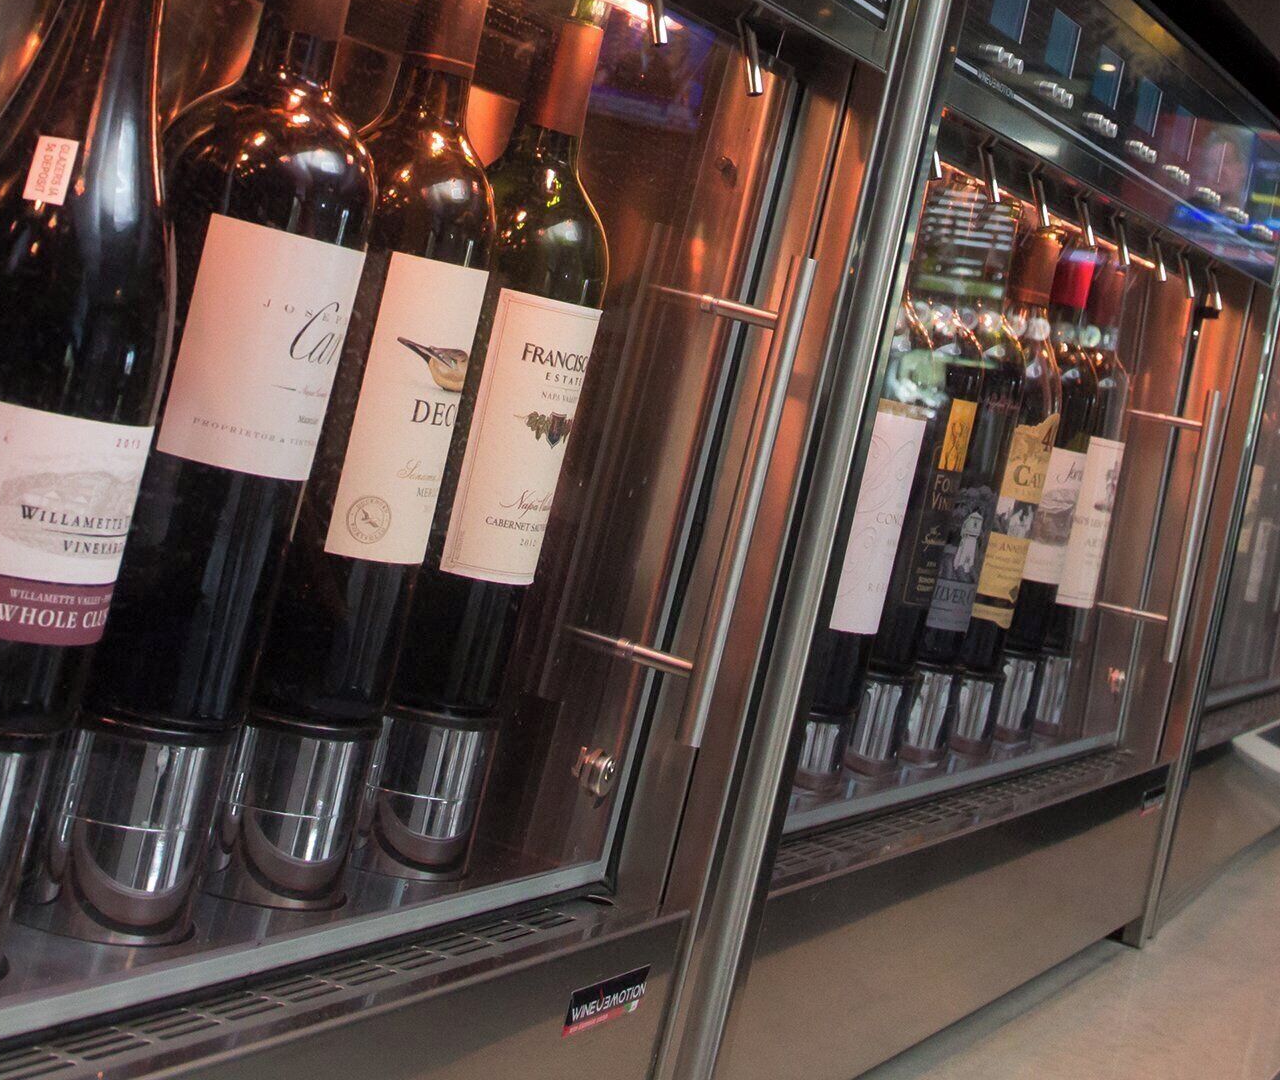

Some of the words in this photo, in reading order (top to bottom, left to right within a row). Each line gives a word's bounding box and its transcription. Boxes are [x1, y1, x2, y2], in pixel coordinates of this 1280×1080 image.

[192, 417, 276, 442] PROPRIETOR
[485, 515, 530, 533] CABERNET
[10, 587, 75, 605] WILLAMETTE
